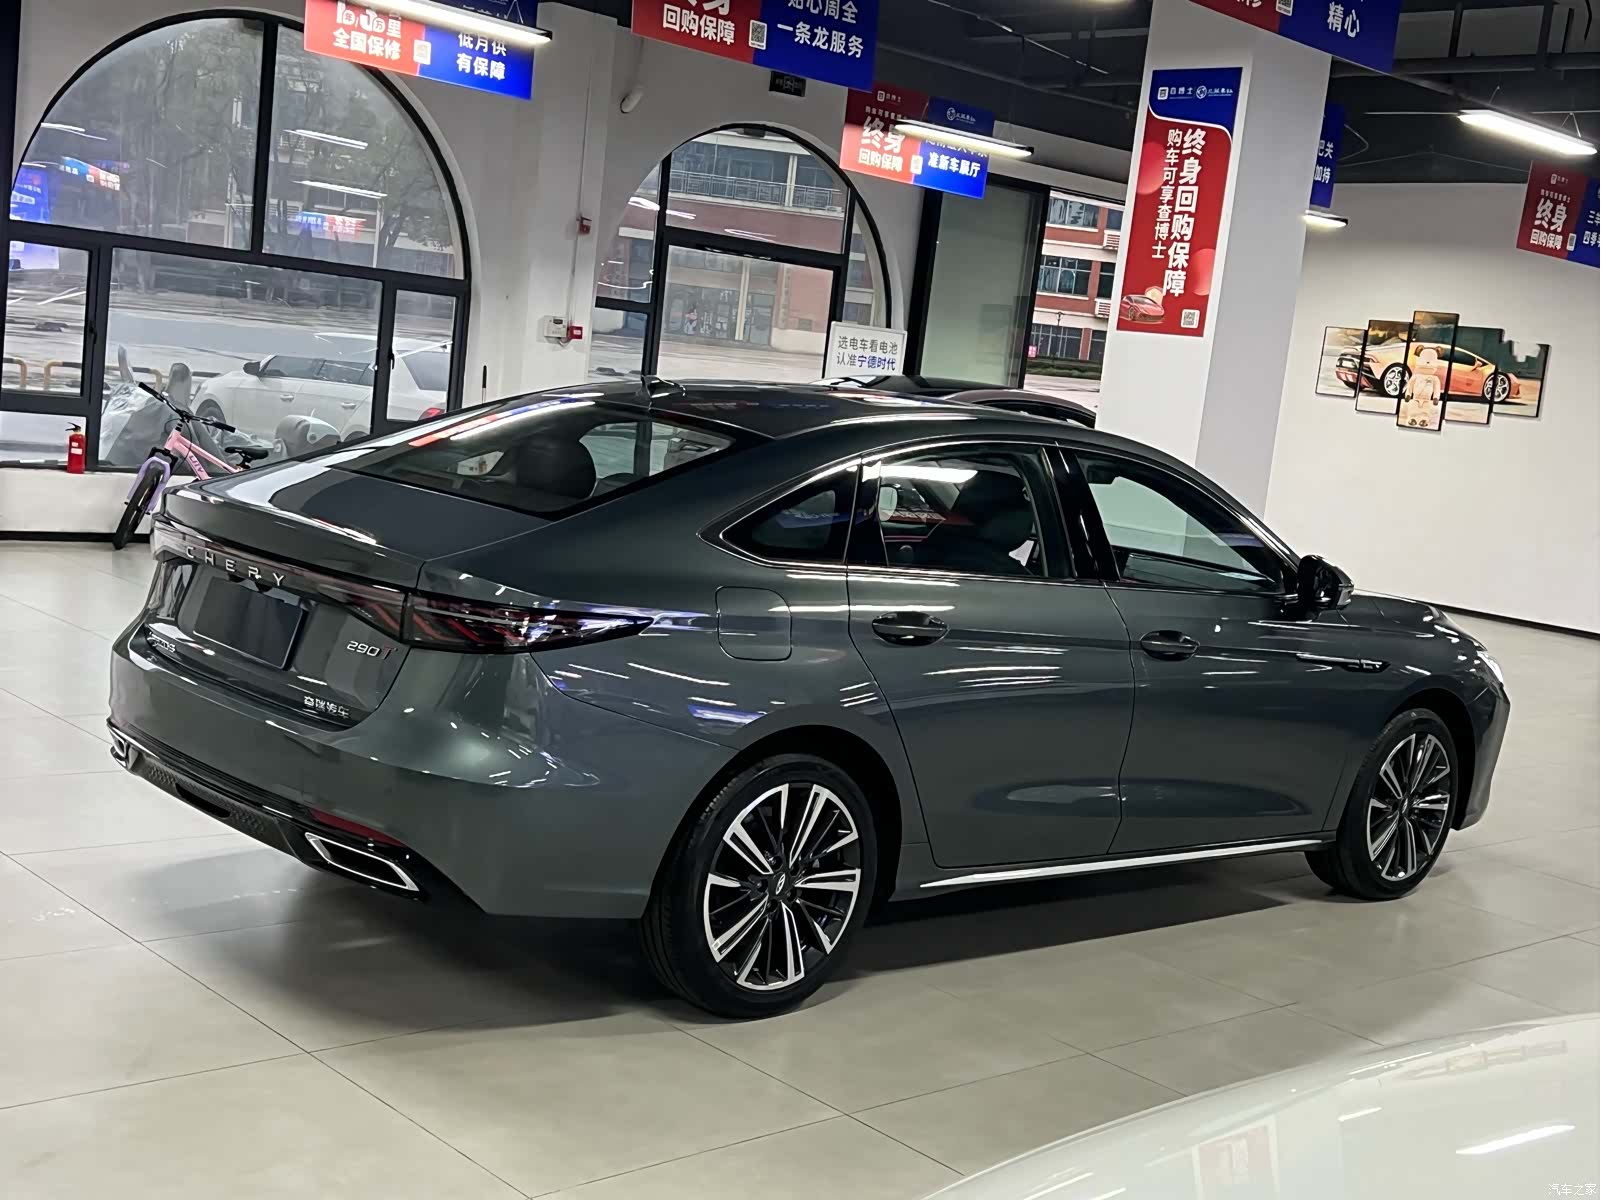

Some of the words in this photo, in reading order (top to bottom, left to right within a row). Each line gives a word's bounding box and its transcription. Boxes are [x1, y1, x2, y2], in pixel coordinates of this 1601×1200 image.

[662, 3, 735, 45] 回购保障
[1327, 1, 1360, 38] 精心
[332, 27, 401, 61] 全国保修
[457, 32, 507, 57] 低月供
[777, 21, 864, 58] 一条龙服务
[456, 52, 506, 80] 有保障
[860, 115, 906, 154] 终身
[858, 147, 904, 173] 回购保障
[927, 151, 981, 178] 准新车展厅
[1151, 128, 1183, 260] 购车可享查博士
[1162, 127, 1207, 298] 终身回购保障
[1534, 198, 1567, 233] 终身
[1529, 228, 1563, 251] 回购保障
[836, 352, 896, 371] 认准宁德时代
[837, 335, 898, 355] 选电车看电池
[186, 546, 285, 587] CHERY
